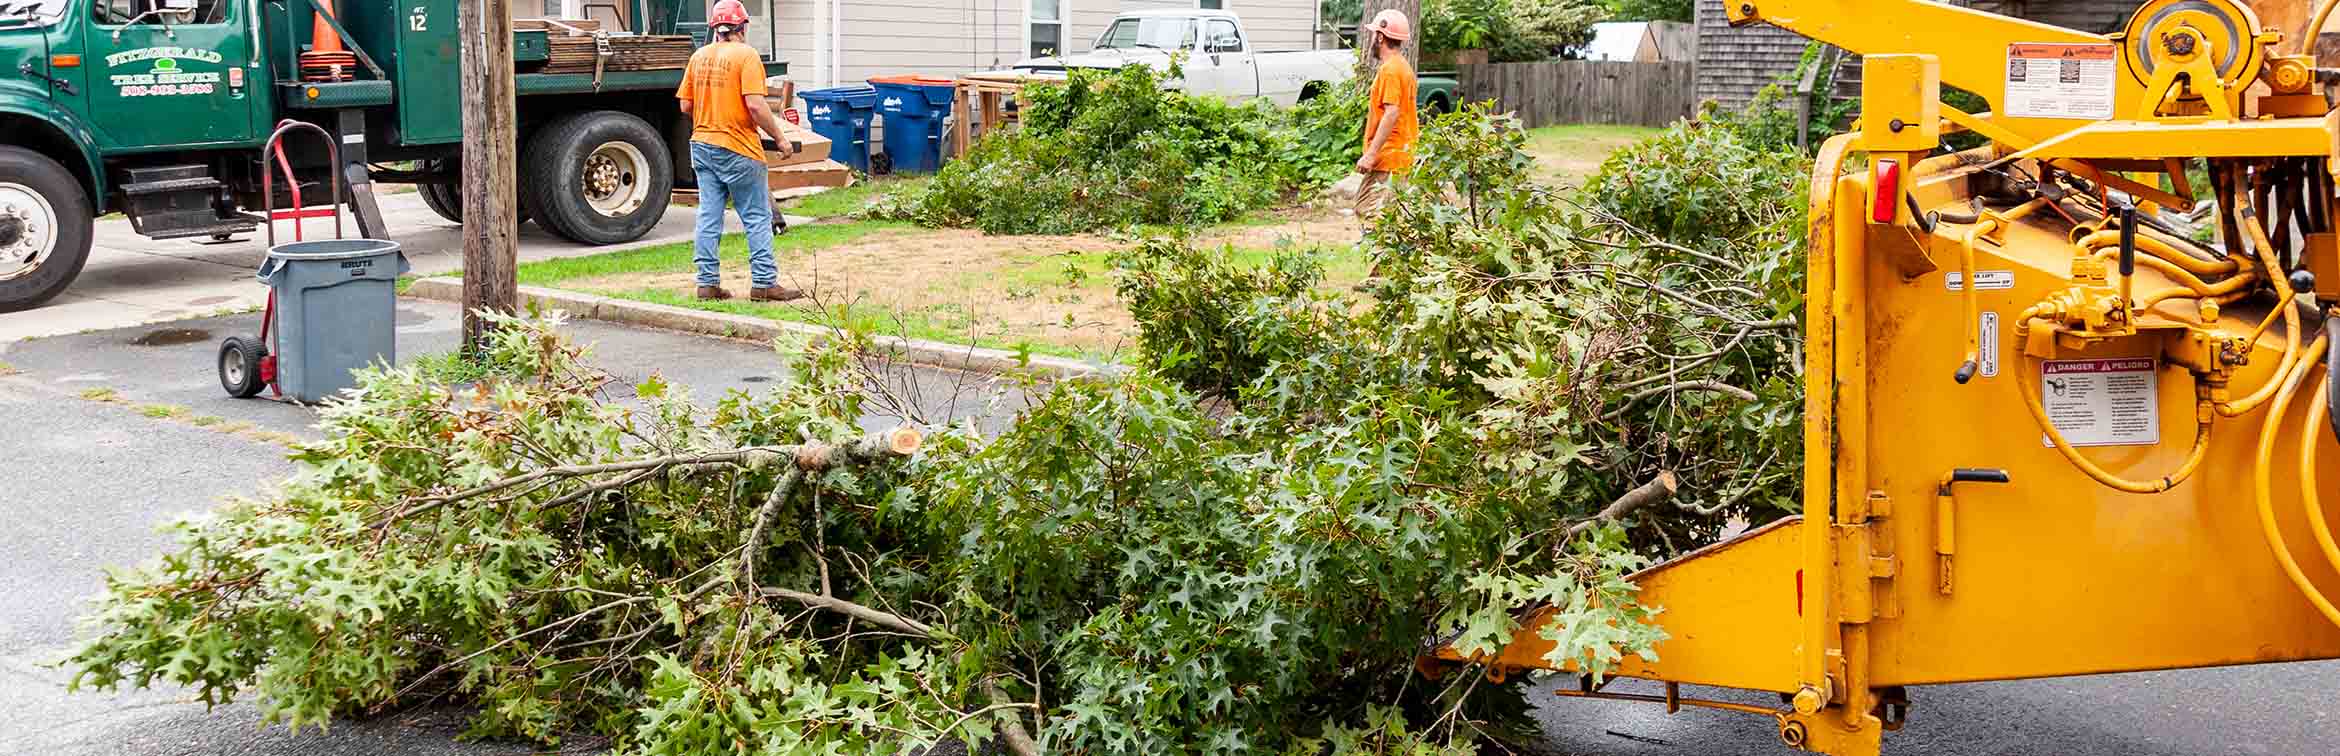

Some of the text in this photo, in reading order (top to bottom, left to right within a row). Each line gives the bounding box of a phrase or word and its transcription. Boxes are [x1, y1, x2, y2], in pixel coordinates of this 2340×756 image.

[410, 15, 426, 31] 12
[105, 47, 222, 67] FITZGERALD
[110, 73, 220, 85] TREE SERVICE
[2058, 361, 2150, 371] DANGER PELIGRO
